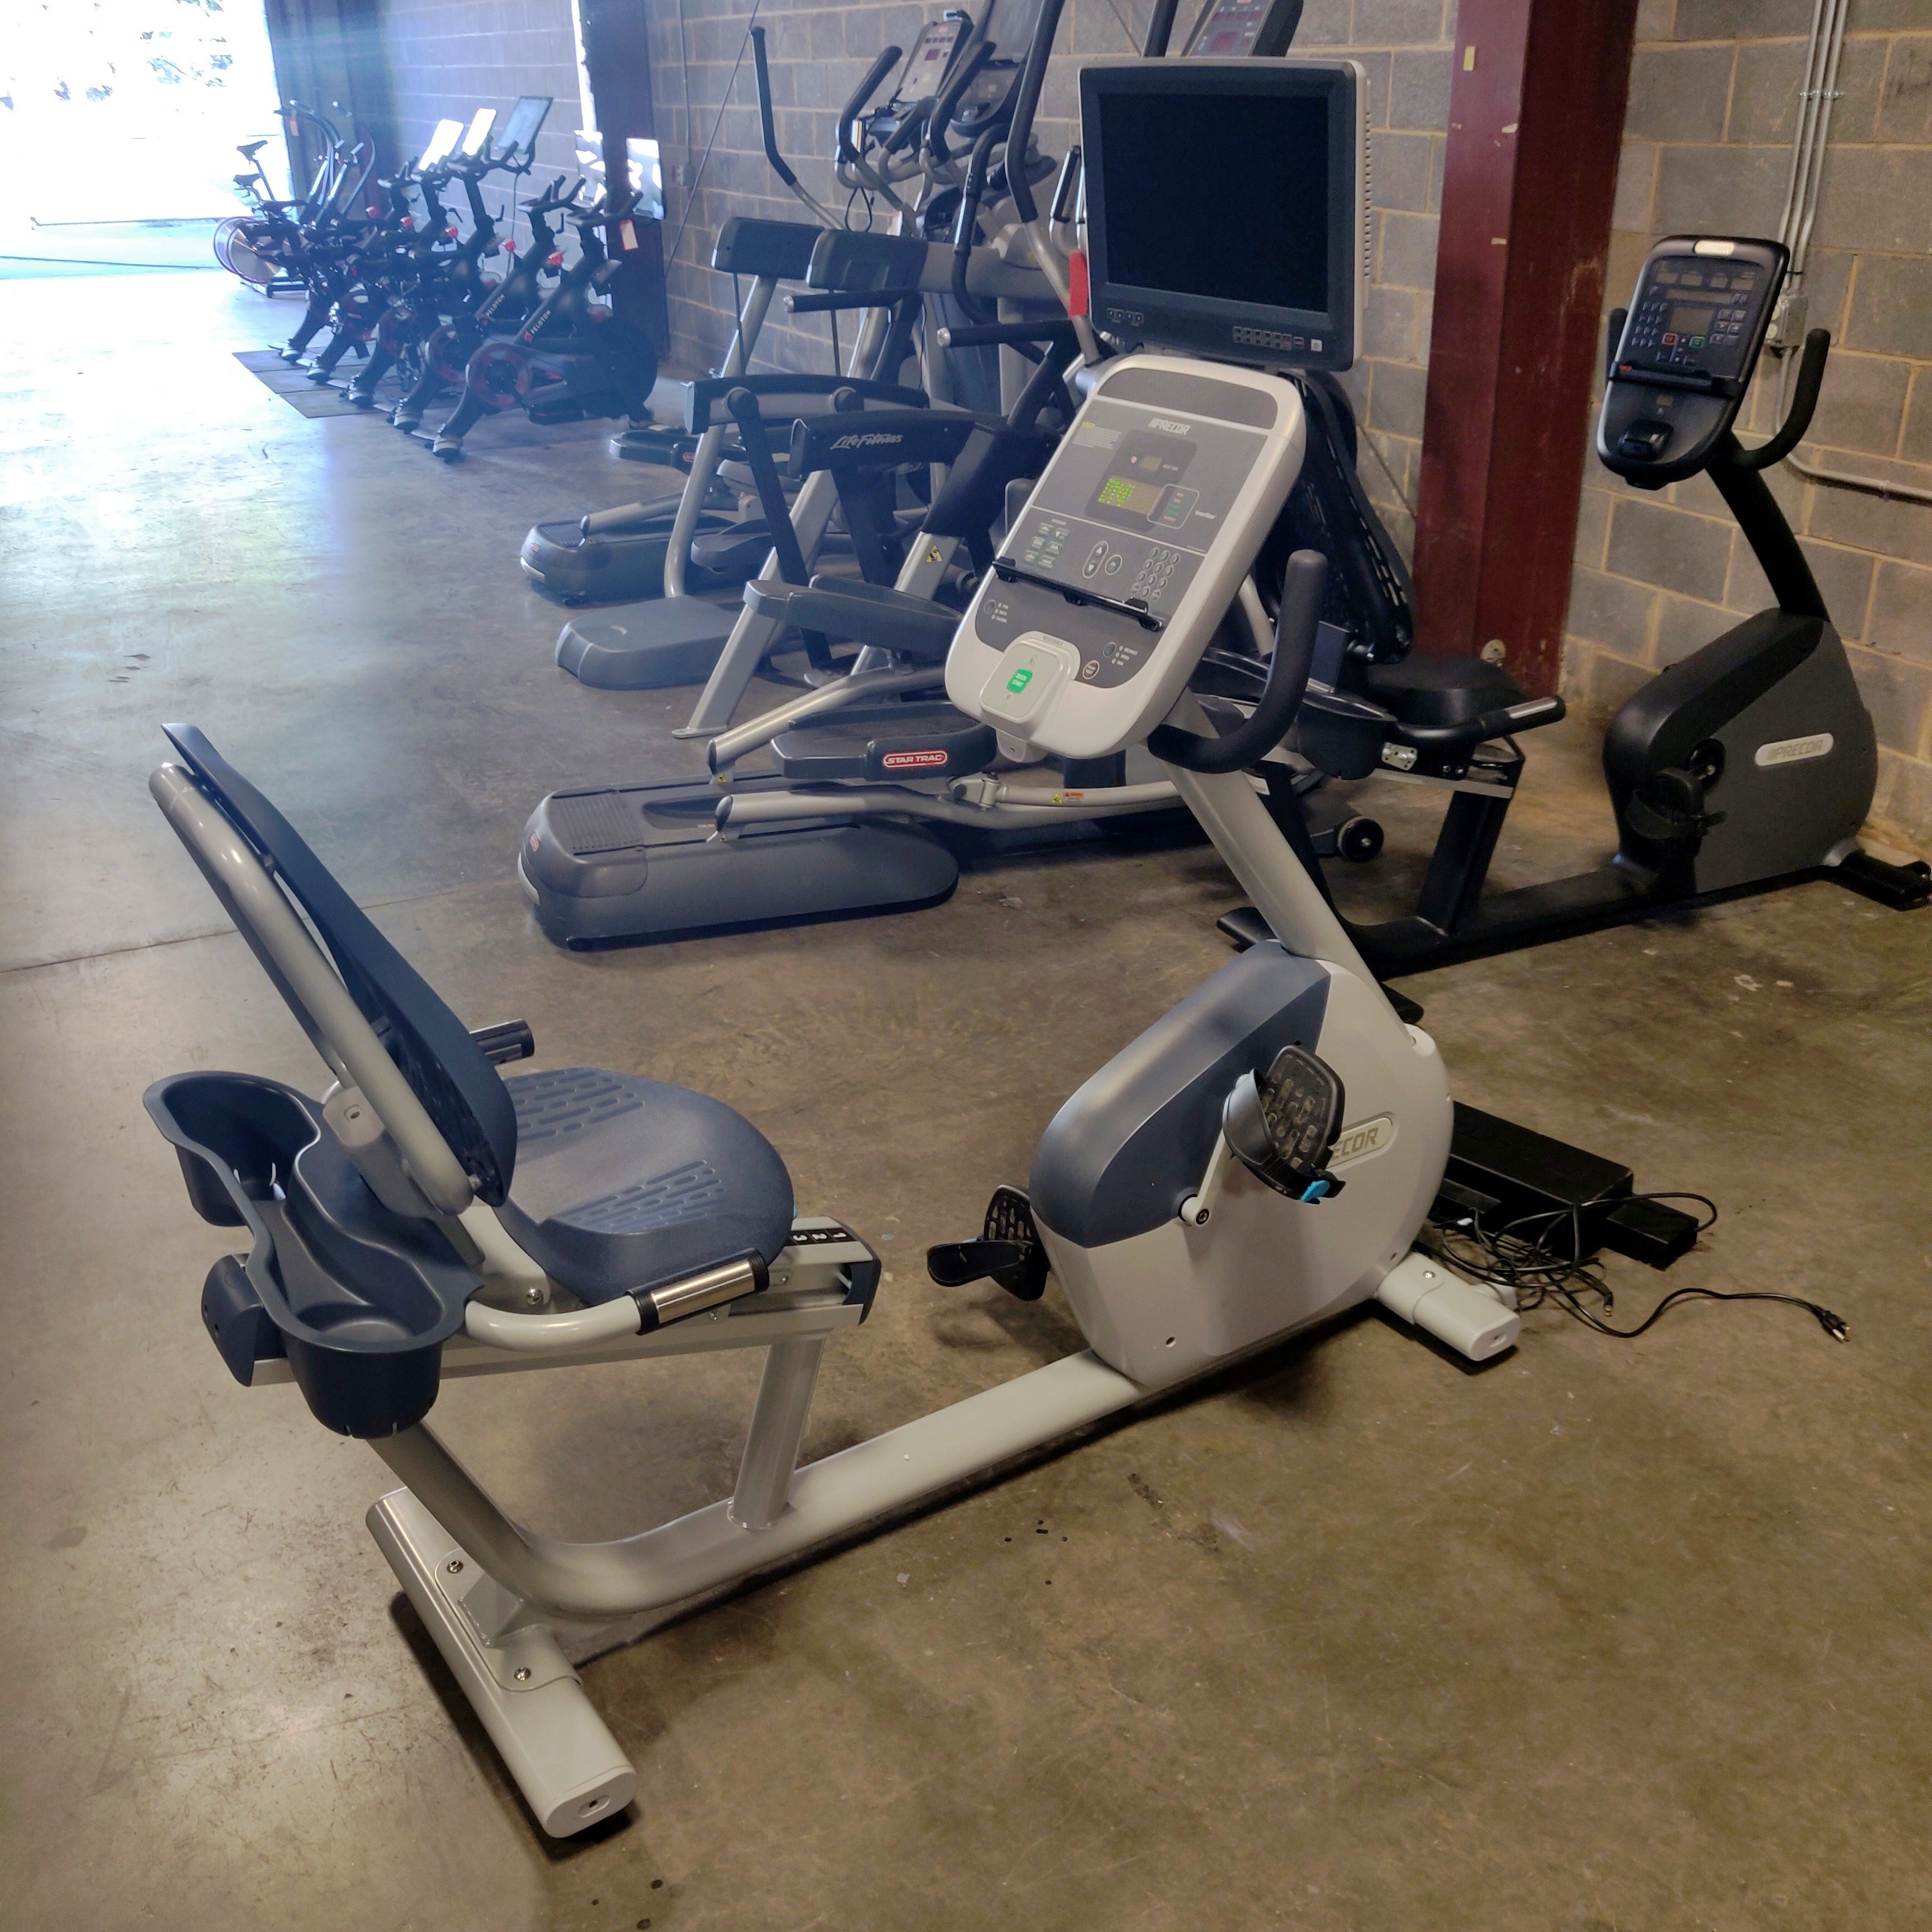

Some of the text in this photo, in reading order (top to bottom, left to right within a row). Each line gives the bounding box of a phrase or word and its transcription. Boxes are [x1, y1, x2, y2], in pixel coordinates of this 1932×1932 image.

[531, 309, 551, 335] PELOTON
[1154, 419, 1191, 435] PRECOR
[830, 434, 859, 450] Life
[1775, 740, 1824, 759] PRECOR
[886, 754, 943, 764] STAR TRAC
[1332, 1127, 1379, 1161] ECOR
